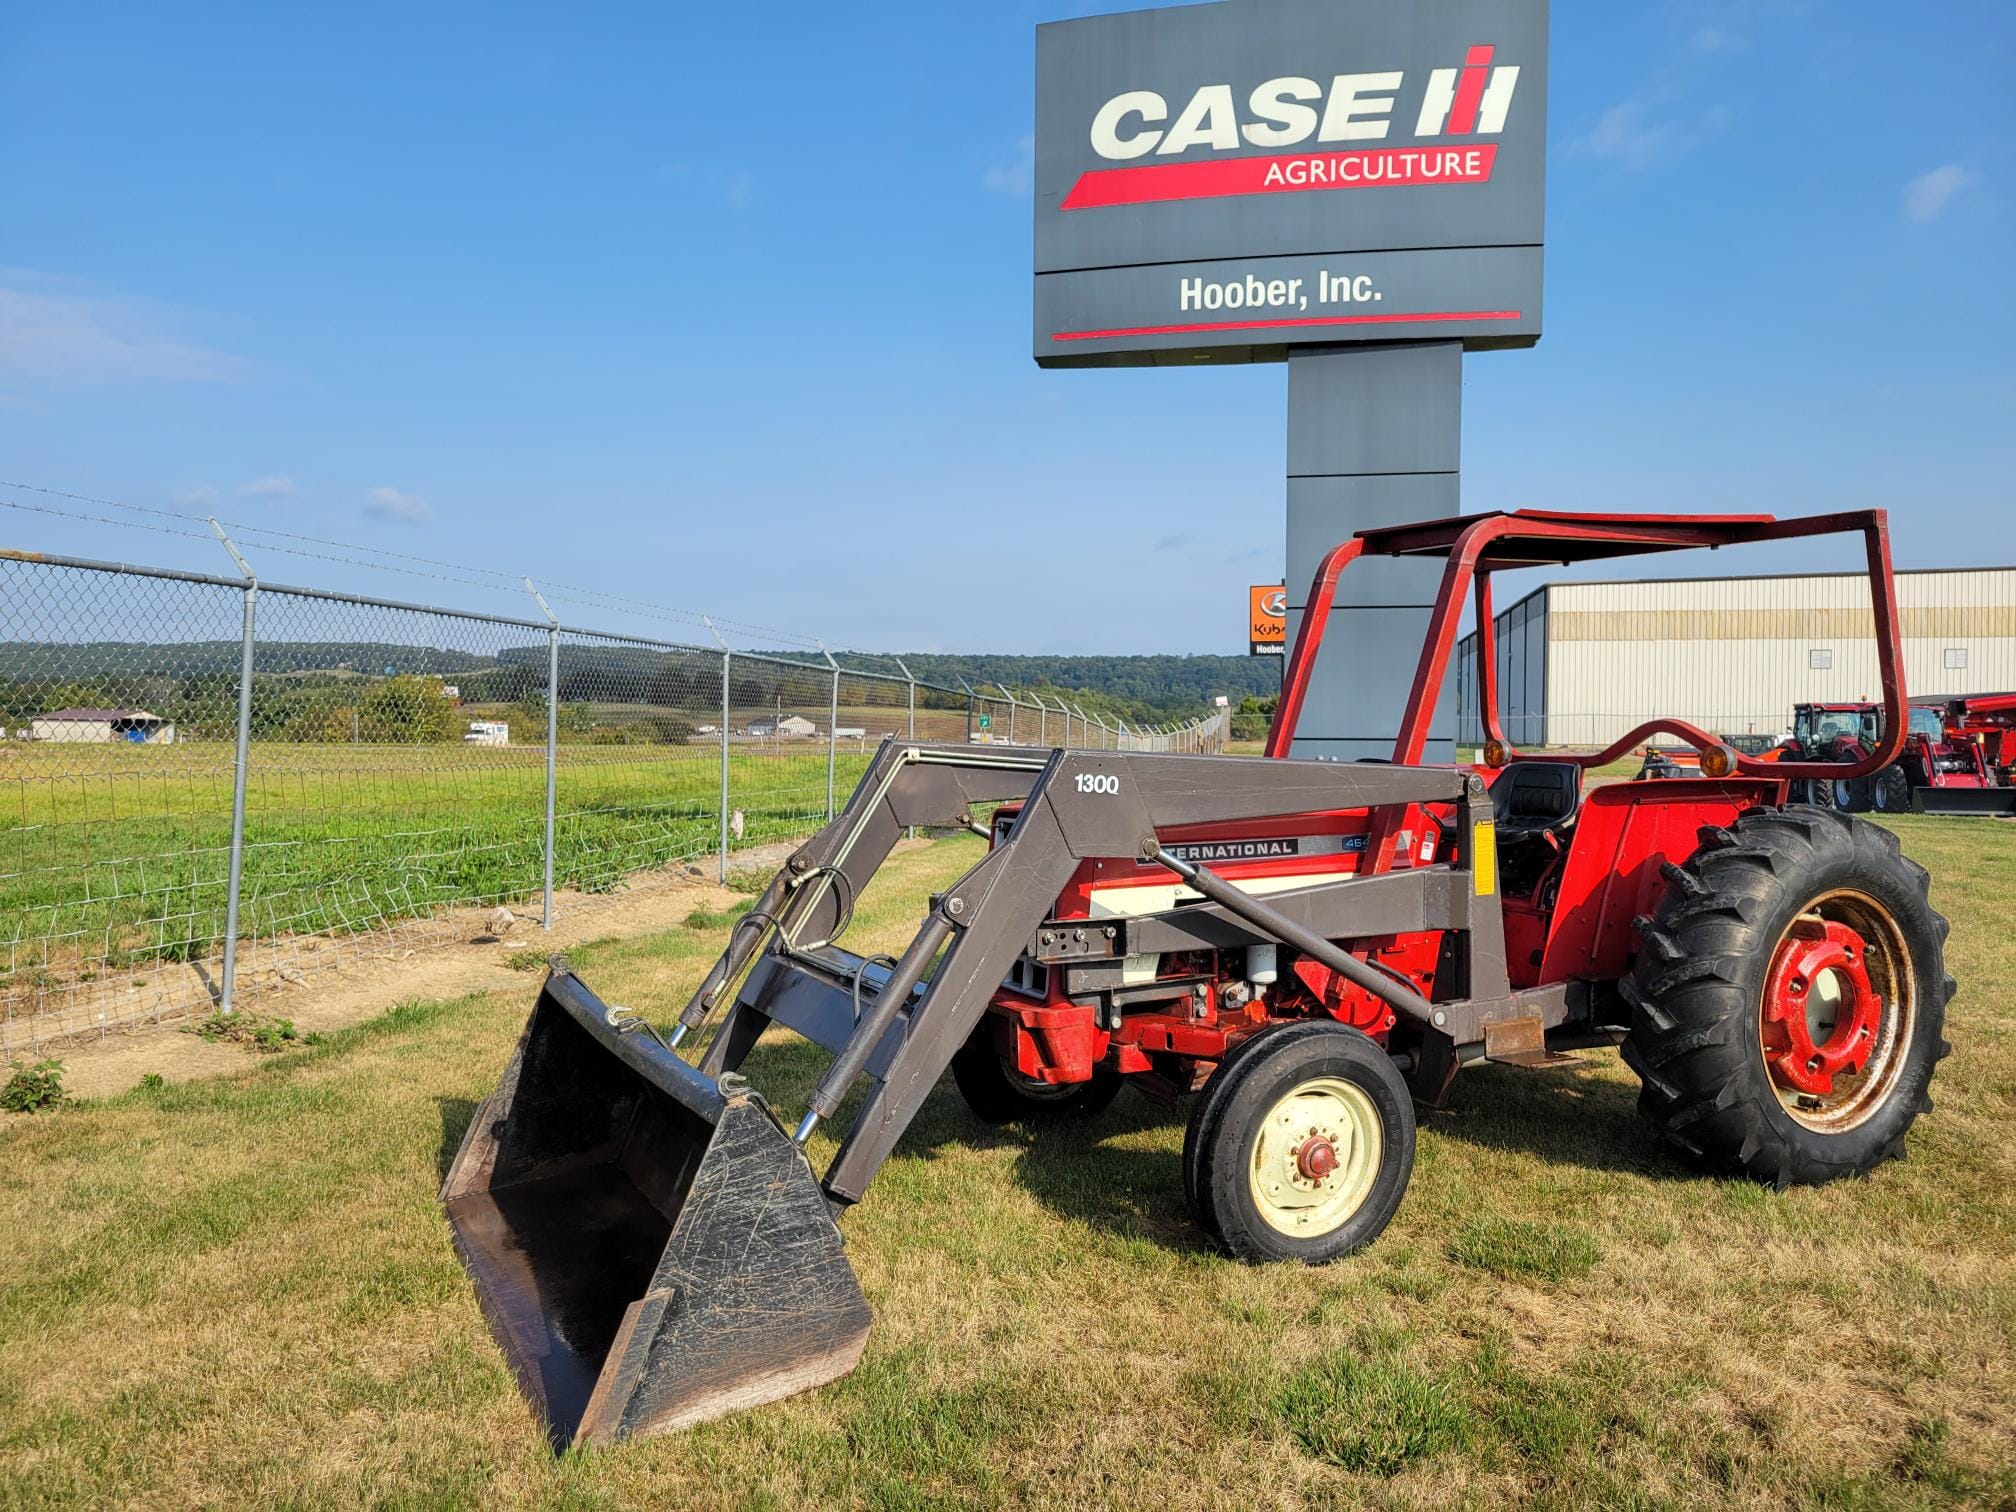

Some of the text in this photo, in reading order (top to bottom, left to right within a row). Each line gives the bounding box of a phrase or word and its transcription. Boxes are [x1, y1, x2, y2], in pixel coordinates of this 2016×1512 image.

[1090, 71, 1403, 160] CASE
[1264, 151, 1481, 186] AGRICULTURE
[1180, 270, 1383, 310] Hoober, Inc.
[1145, 842, 1293, 861] TERNATIONAL
